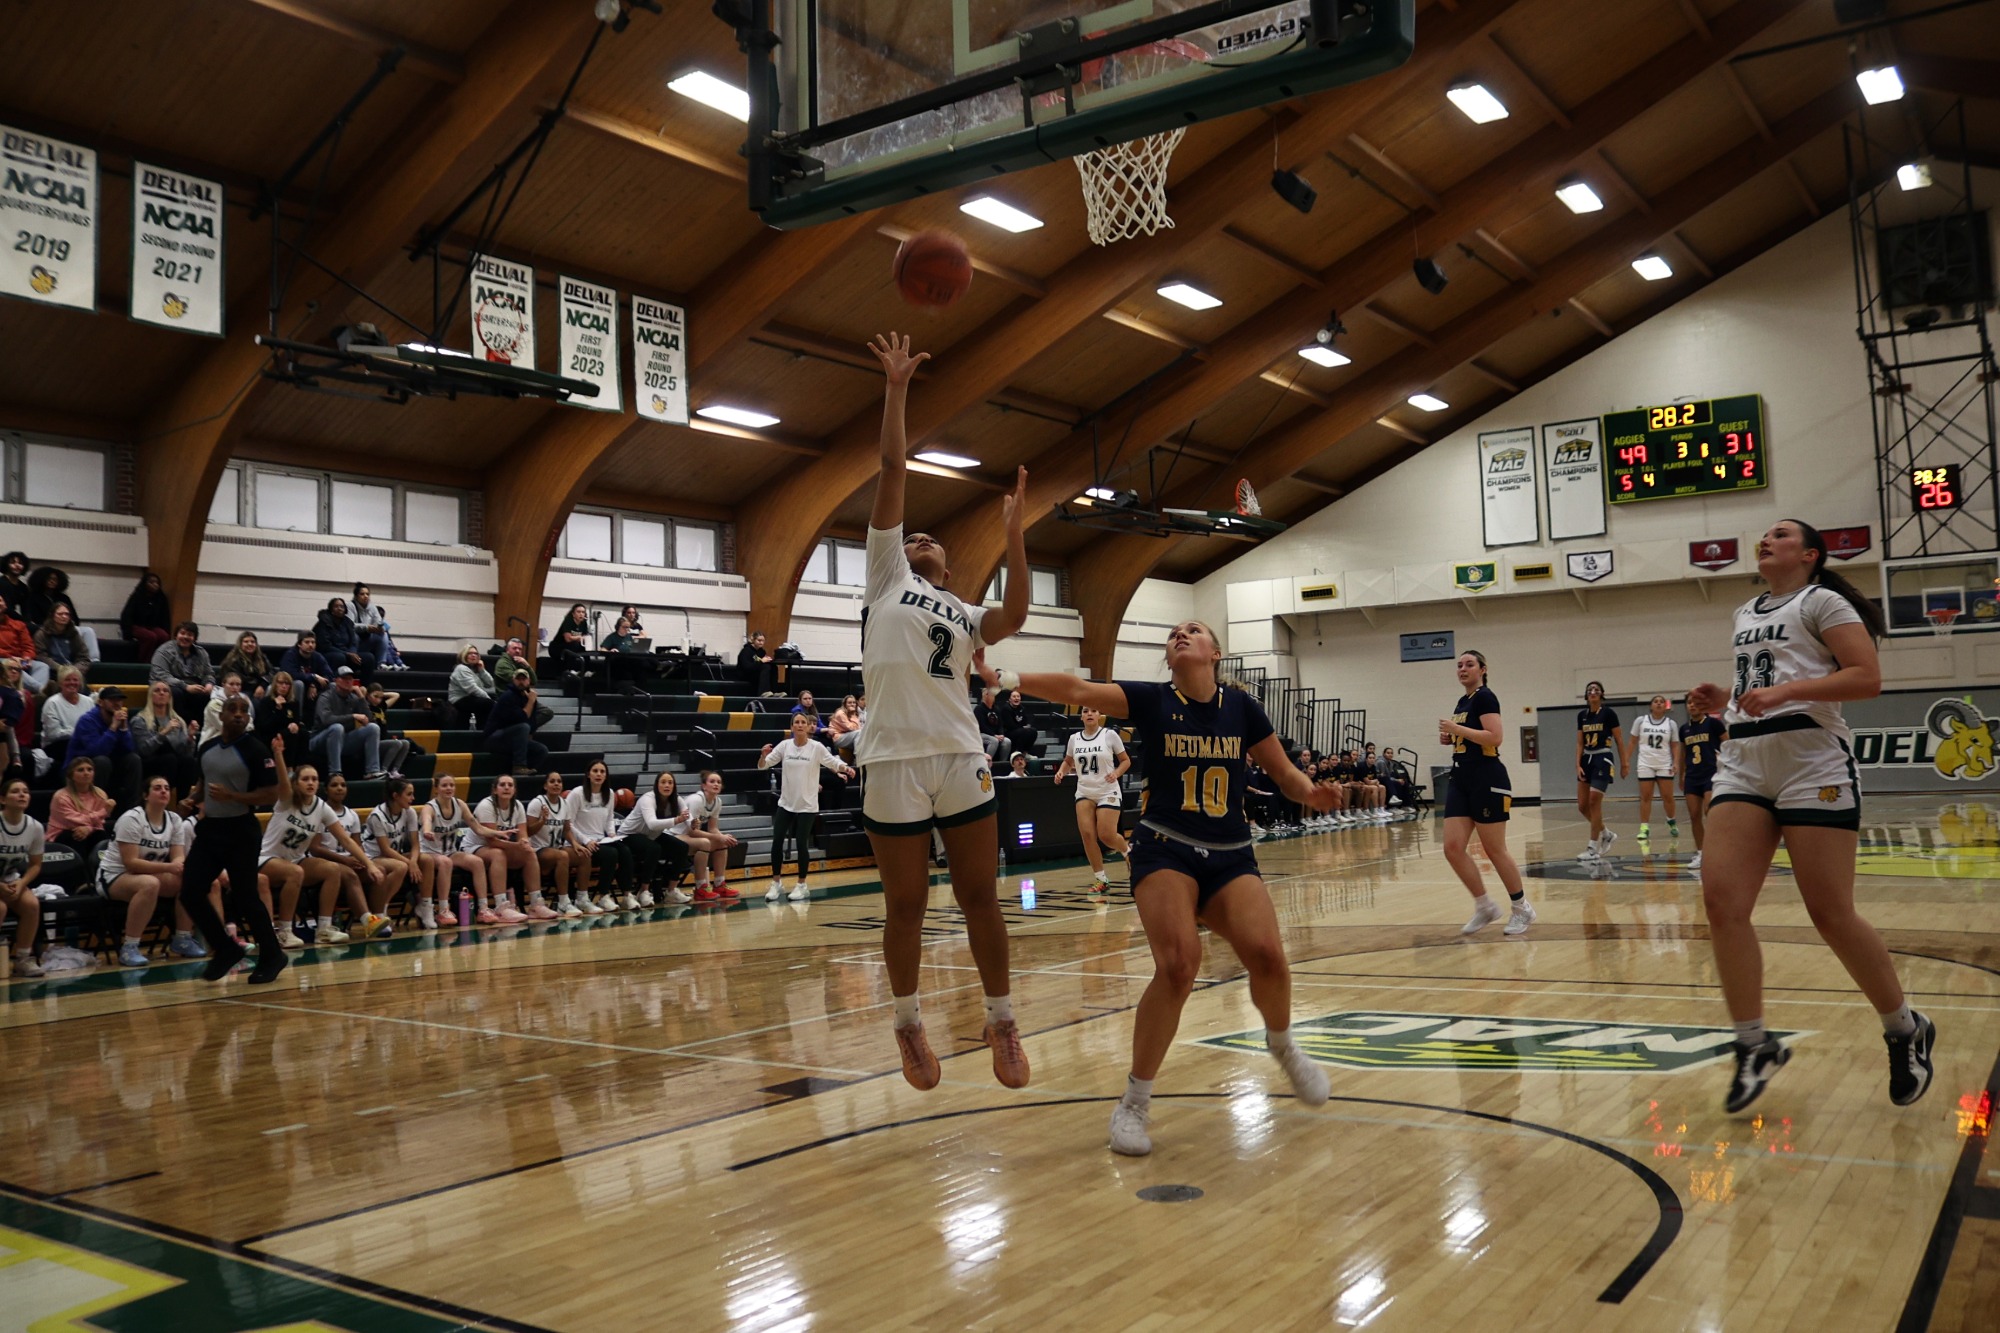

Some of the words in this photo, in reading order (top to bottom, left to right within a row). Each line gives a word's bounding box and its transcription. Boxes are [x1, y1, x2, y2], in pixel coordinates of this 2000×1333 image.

[3, 131, 88, 170] DELVAL
[3, 167, 87, 210] NCAA
[142, 169, 216, 205] DELVAL
[143, 202, 214, 239] NCAA
[14, 229, 71, 262] 2019
[141, 232, 180, 252] SECOND
[182, 242, 216, 260] ROUND
[152, 256, 203, 284] 2021
[476, 259, 528, 285] DELVAL
[475, 285, 527, 316] NCAA
[564, 282, 613, 307] DELVAL
[565, 307, 610, 336] NCAA
[637, 302, 682, 325] DELVAL
[580, 333, 602, 347] FIRST
[637, 325, 679, 352] NCAA
[576, 344, 602, 359] ROUND
[651, 350, 670, 363] FIRST
[570, 354, 605, 378] 2023
[647, 360, 672, 374] ROUND
[644, 370, 677, 392] 2025
[1651, 403, 1696, 430] 28.2
[1719, 420, 1749, 433] GUEST
[1564, 427, 1586, 437] GOLF
[1613, 434, 1646, 447] AGGIES
[1671, 432, 1693, 441] PERIOD
[1677, 441, 1689, 459] 3
[1726, 432, 1754, 455] 31
[1490, 459, 1525, 473] MAC
[1555, 448, 1591, 464] MAC
[1620, 445, 1648, 466] 49
[1663, 461, 1686, 470] PLAYER
[1688, 459, 1704, 467] FOUL
[1735, 453, 1756, 462] FOULS
[1551, 465, 1599, 478] CHAMPIONS
[1615, 467, 1635, 475] FOULS
[1714, 464, 1726, 479] 4
[1742, 459, 1755, 477] 2
[1914, 468, 1948, 485] 28.2
[1487, 475, 1532, 487] CHAMPIONS
[1498, 485, 1521, 493] WOMEN
[1621, 474, 1634, 492] 5
[1643, 472, 1655, 488] 4
[1920, 482, 1953, 508] 26
[927, 622, 955, 680] 2
[1733, 649, 1776, 702] 33
[1164, 733, 1242, 760] NEUMANN
[1647, 734, 1663, 749] 42
[1853, 730, 1936, 764] DEL
[1078, 754, 1100, 776] 24
[1691, 745, 1703, 765] 3
[1181, 765, 1229, 818] 10
[281, 827, 308, 850] 22
